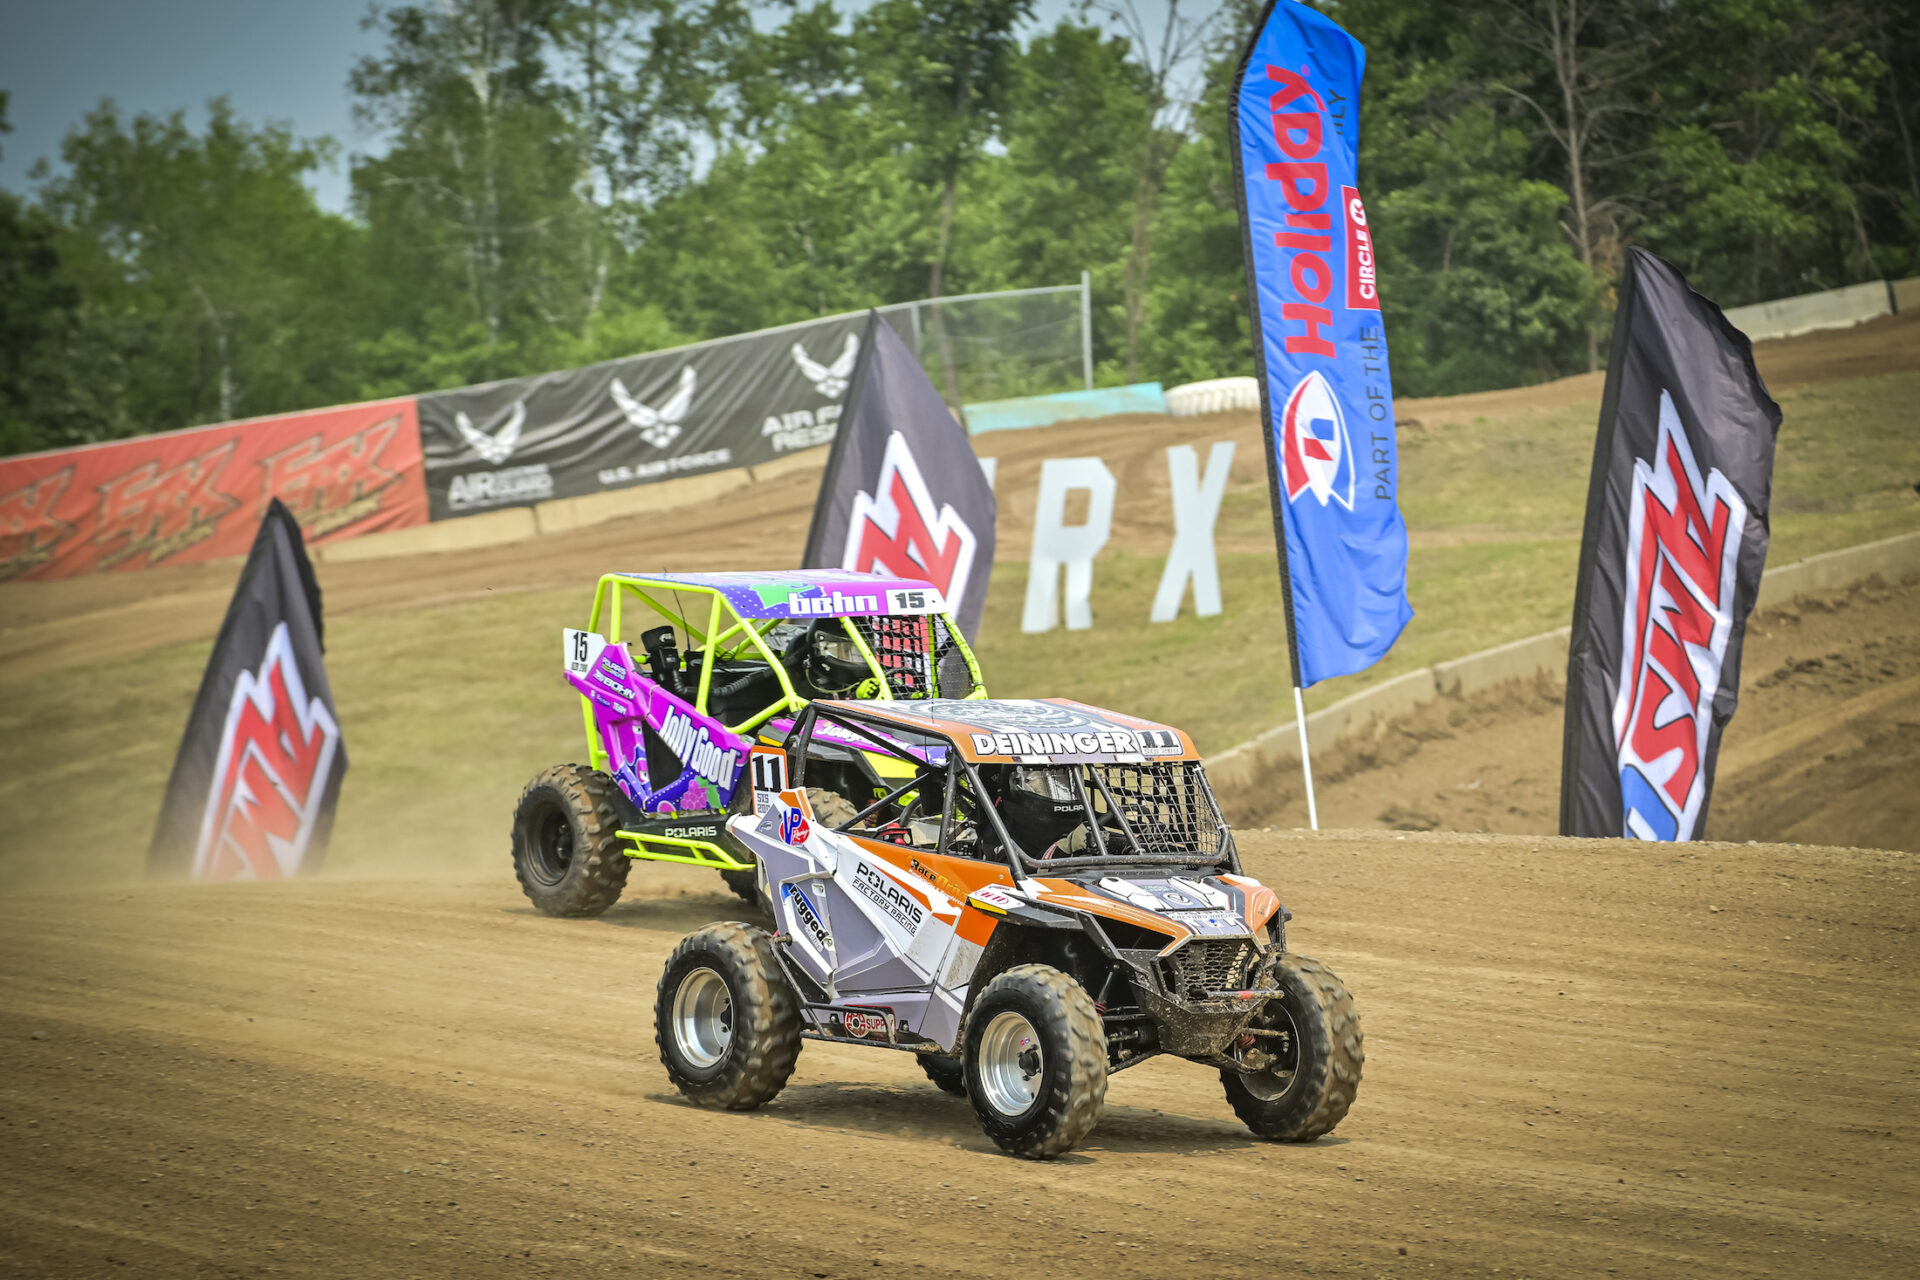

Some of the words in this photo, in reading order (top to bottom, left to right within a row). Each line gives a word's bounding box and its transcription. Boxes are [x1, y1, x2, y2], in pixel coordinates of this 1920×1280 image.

[1265, 63, 1336, 359] Holiday
[1356, 229, 1375, 299] CIRCLE
[1360, 327, 1382, 376] THE
[1366, 386, 1387, 421] OF
[1371, 431, 1392, 500] PART
[979, 441, 1237, 634] RX
[894, 592, 926, 609] 15
[573, 631, 588, 662] 15
[969, 731, 1138, 756] DEININGER
[1137, 730, 1179, 749] 11
[752, 755, 782, 793] 11
[665, 826, 717, 838] POLARIS
[783, 807, 802, 845] VP
[910, 857, 937, 883] Race
[852, 879, 890, 911] FACTORY
[890, 907, 917, 936] RACING
[856, 861, 923, 924] POLARIS
[789, 885, 830, 946] rugged
